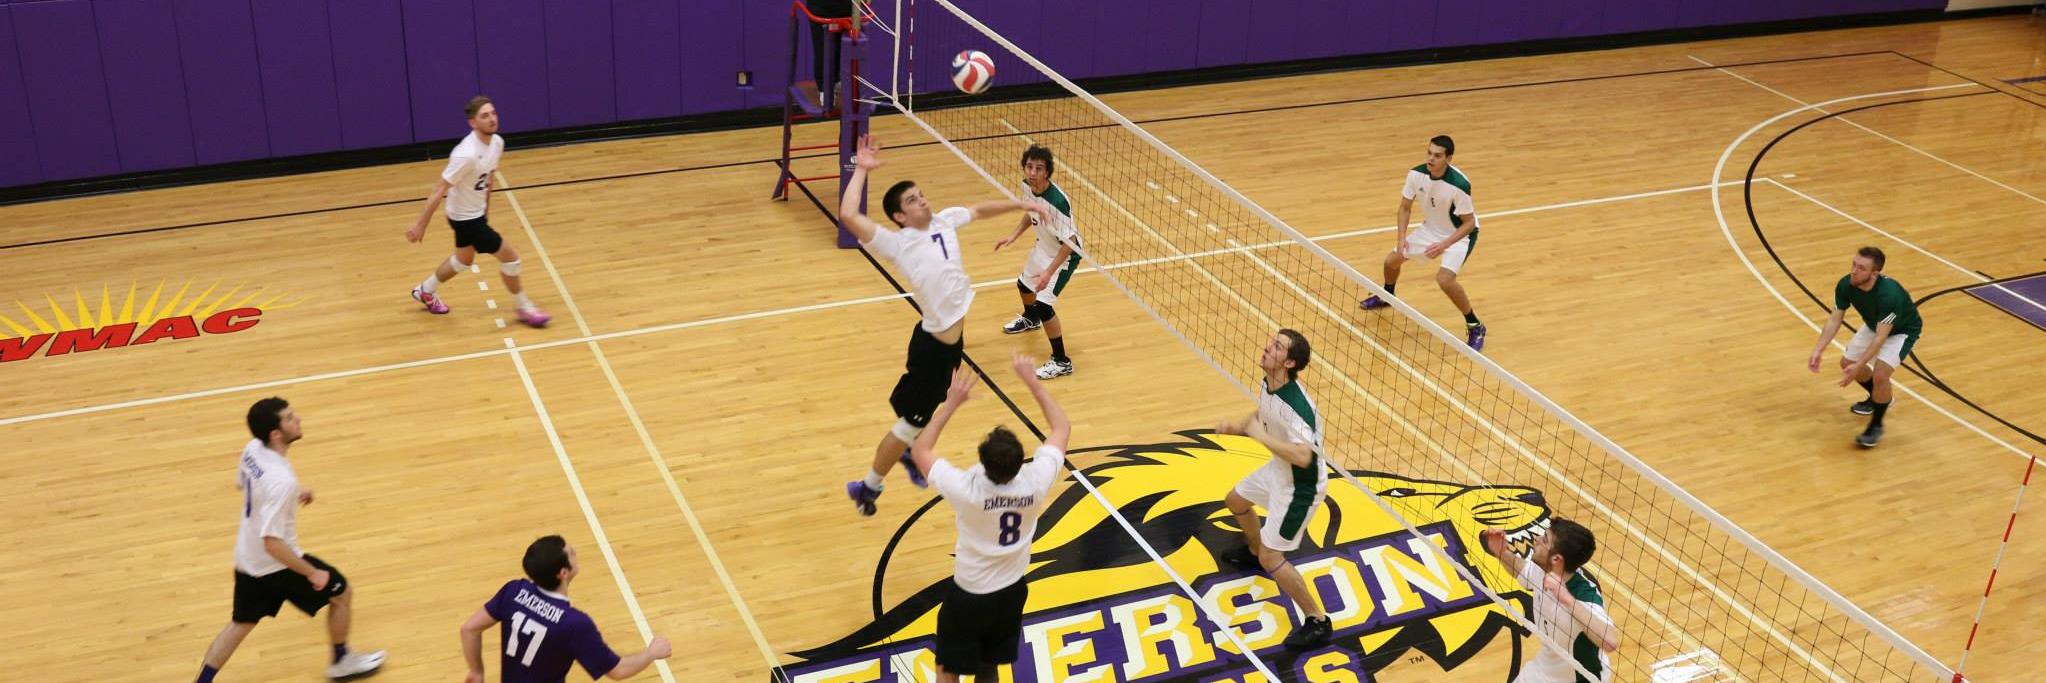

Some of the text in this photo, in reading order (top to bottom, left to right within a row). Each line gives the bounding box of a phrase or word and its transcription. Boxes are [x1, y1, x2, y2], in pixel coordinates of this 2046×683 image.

[931, 233, 949, 260] 7
[984, 494, 1034, 511] EMERSON
[998, 511, 1022, 547] 8
[514, 588, 565, 625] EMERSON
[794, 532, 1475, 683] ERSON
[506, 611, 548, 667] 17
[1407, 655, 1425, 665] TM
